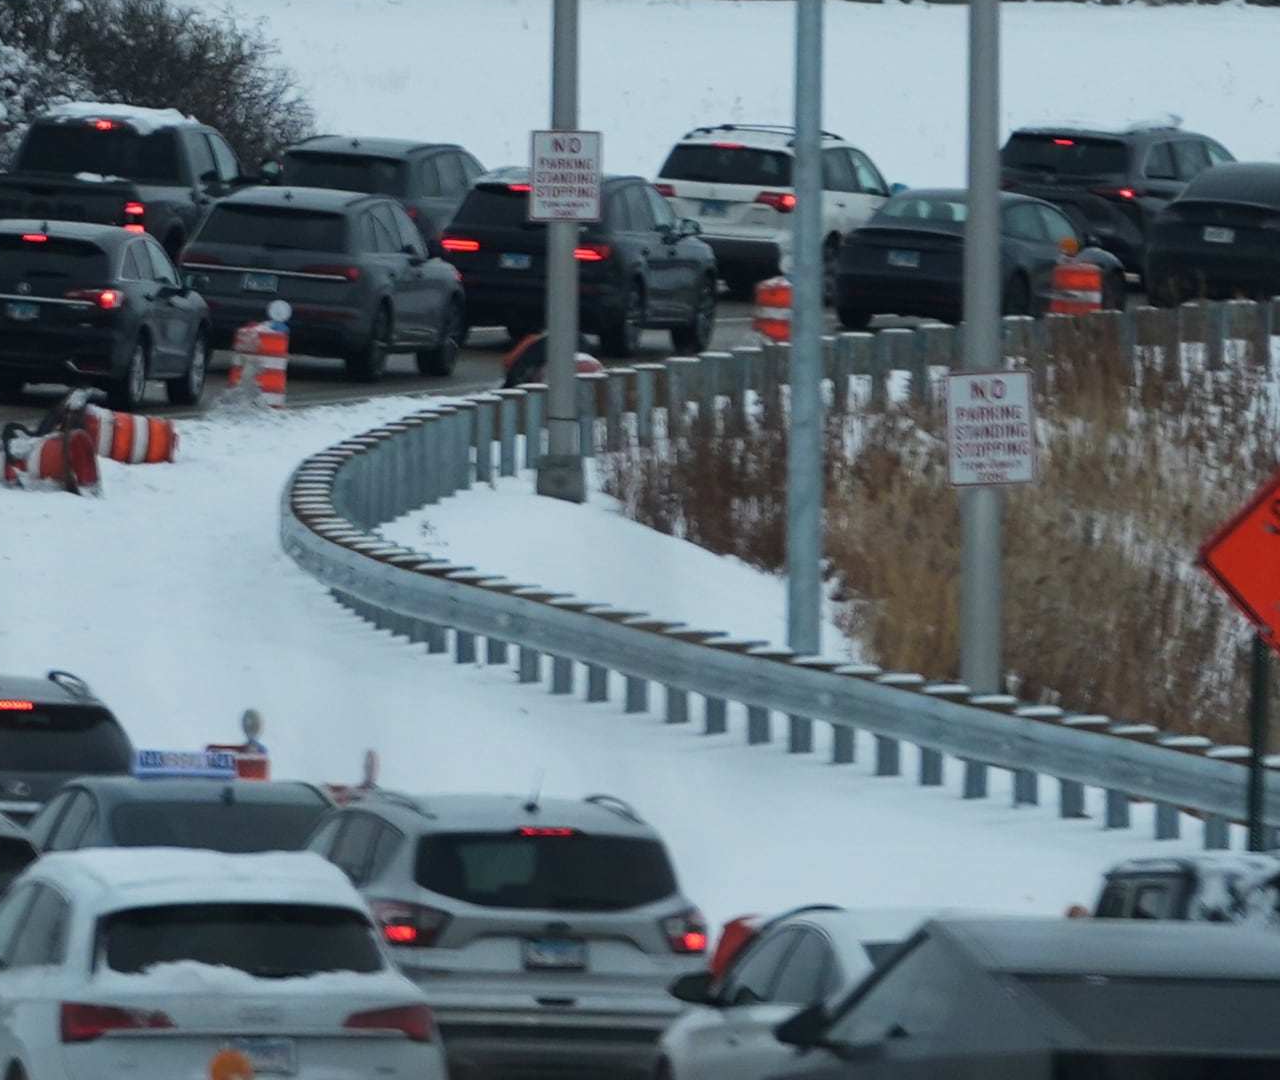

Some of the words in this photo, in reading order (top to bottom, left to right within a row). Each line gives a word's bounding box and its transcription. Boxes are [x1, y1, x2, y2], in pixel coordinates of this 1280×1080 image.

[552, 137, 582, 153] NO
[538, 158, 594, 170] PARKING
[536, 171, 597, 185] STANDING
[535, 185, 597, 198] STOPPING
[970, 379, 1008, 399] NO
[955, 405, 1023, 421] PARKING
[955, 423, 1028, 440] STANDING
[955, 440, 1030, 458] STOPPING
